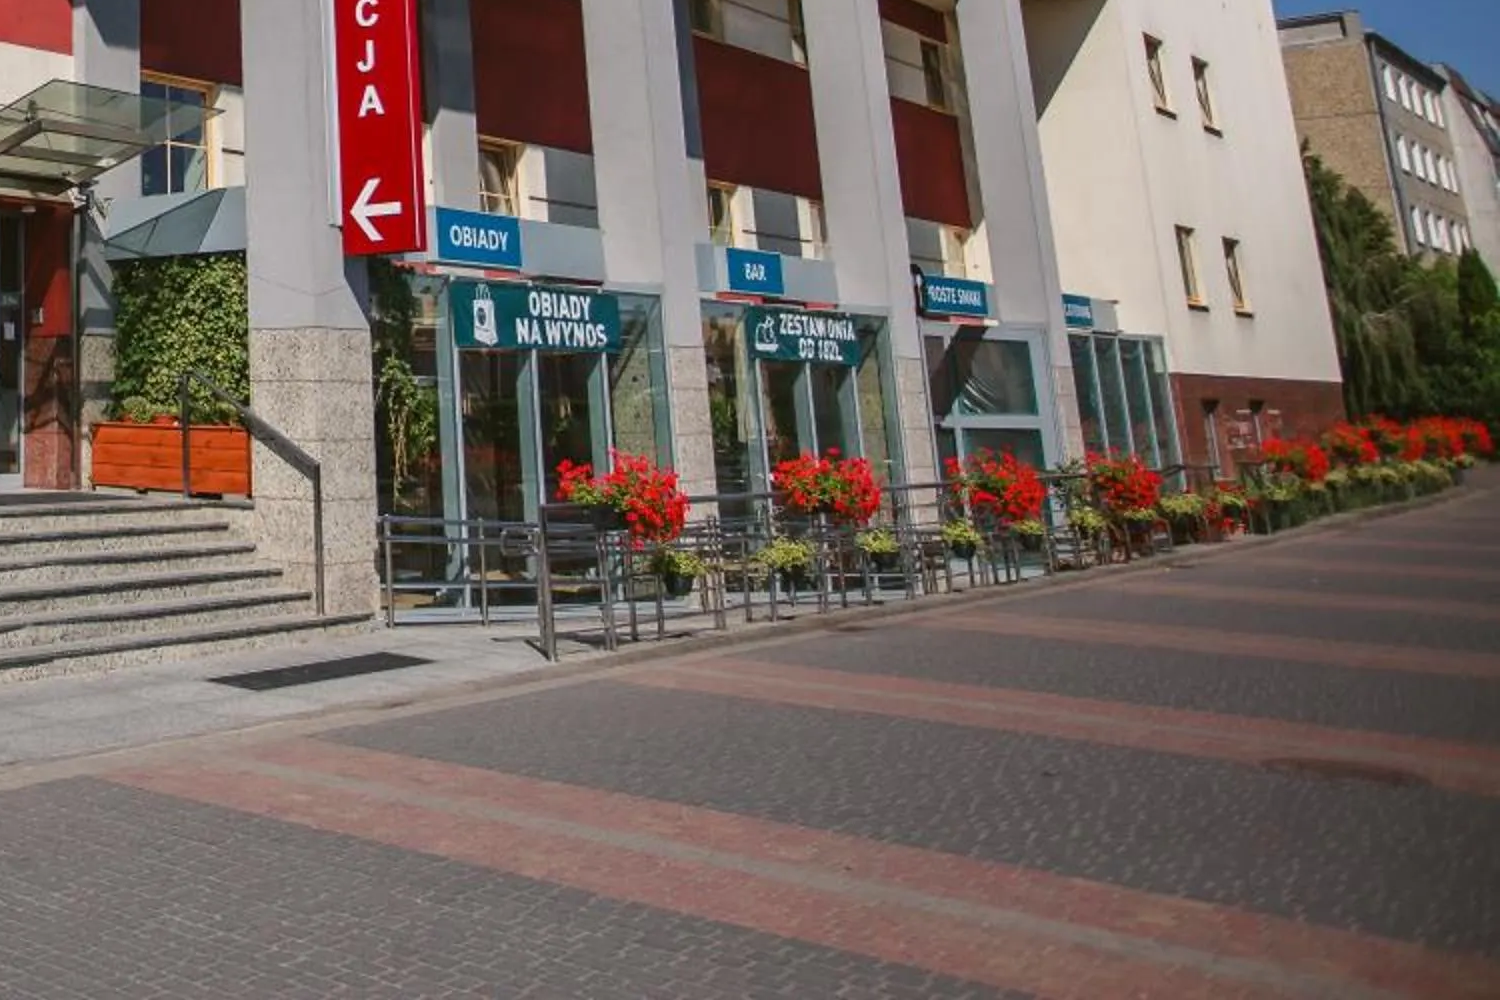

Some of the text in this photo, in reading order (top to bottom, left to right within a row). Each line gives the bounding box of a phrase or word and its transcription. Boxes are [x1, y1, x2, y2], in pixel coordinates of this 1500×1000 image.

[450, 224, 508, 251] OBIADY
[529, 291, 591, 321] OBIADY
[515, 318, 608, 347] NA WYNOS
